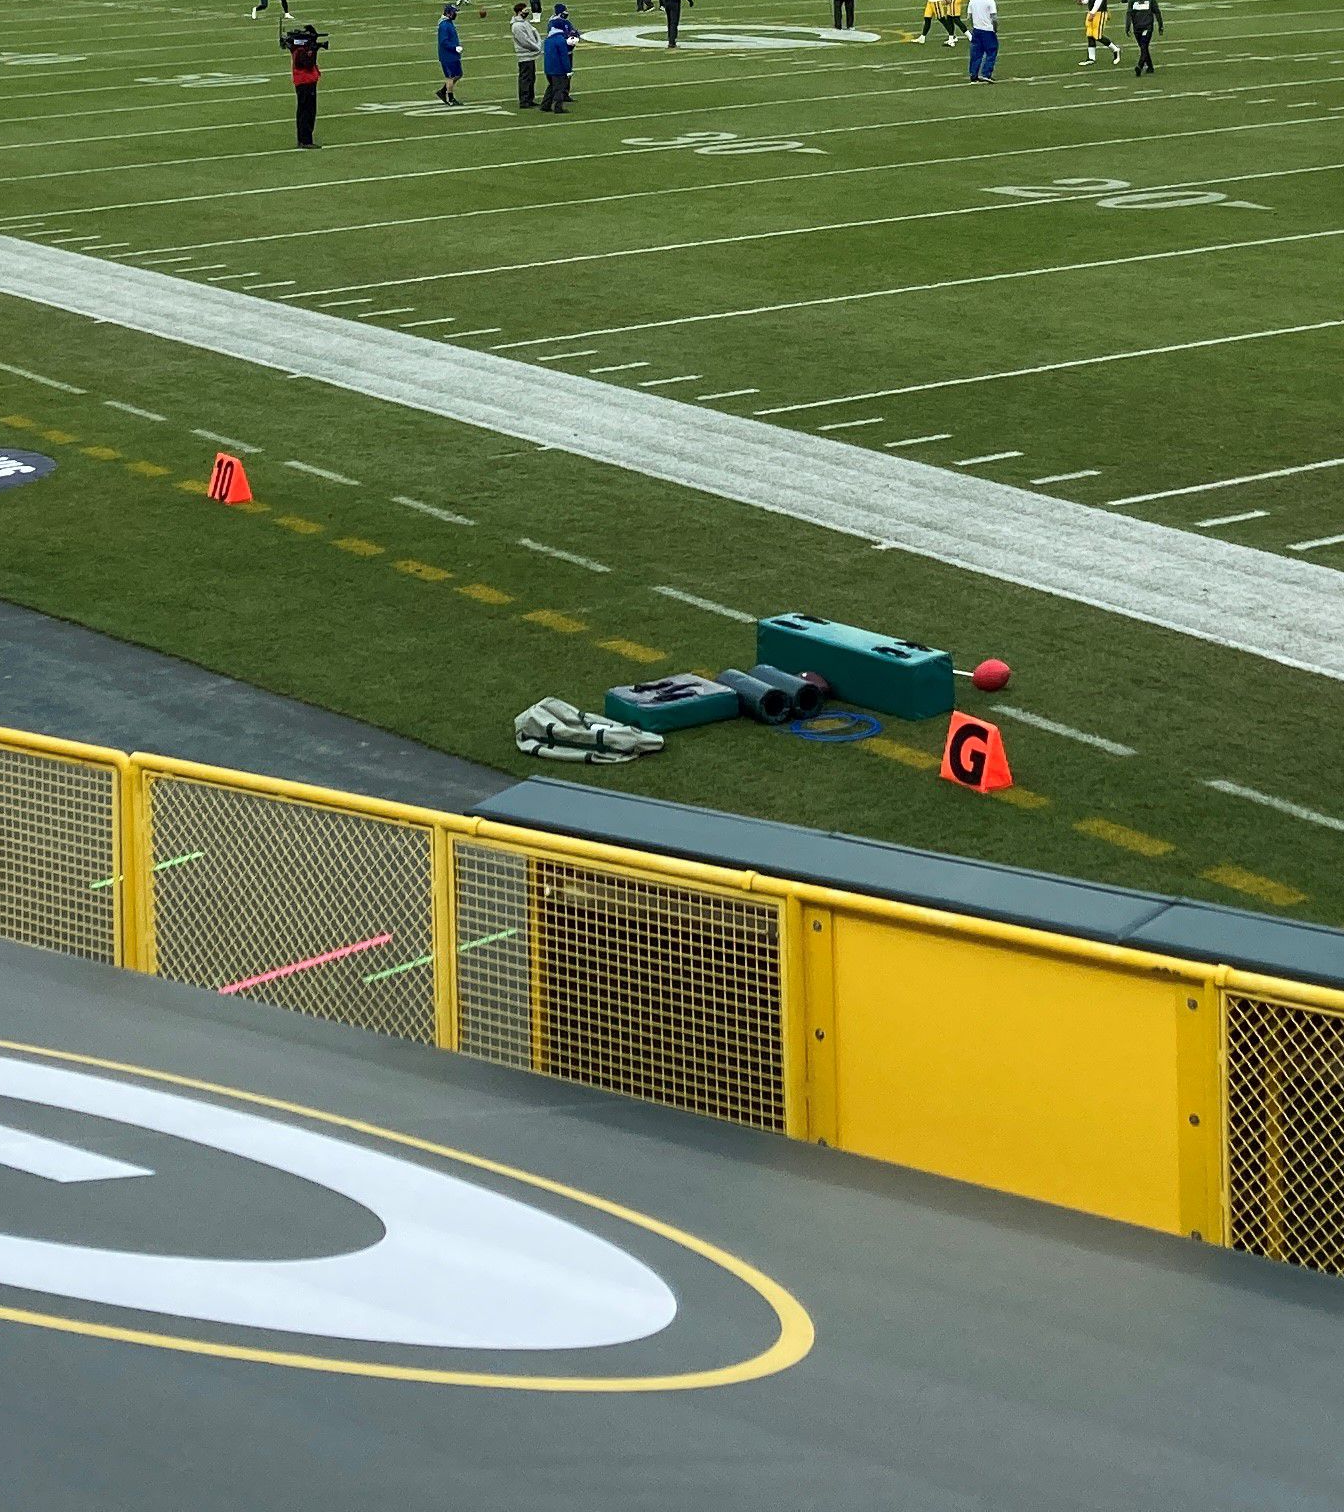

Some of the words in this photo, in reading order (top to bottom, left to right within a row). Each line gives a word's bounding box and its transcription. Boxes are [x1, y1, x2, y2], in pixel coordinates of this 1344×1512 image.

[621, 131, 804, 155] 30
[977, 178, 1227, 209] 20
[212, 458, 234, 502] 10
[950, 723, 989, 787] G
